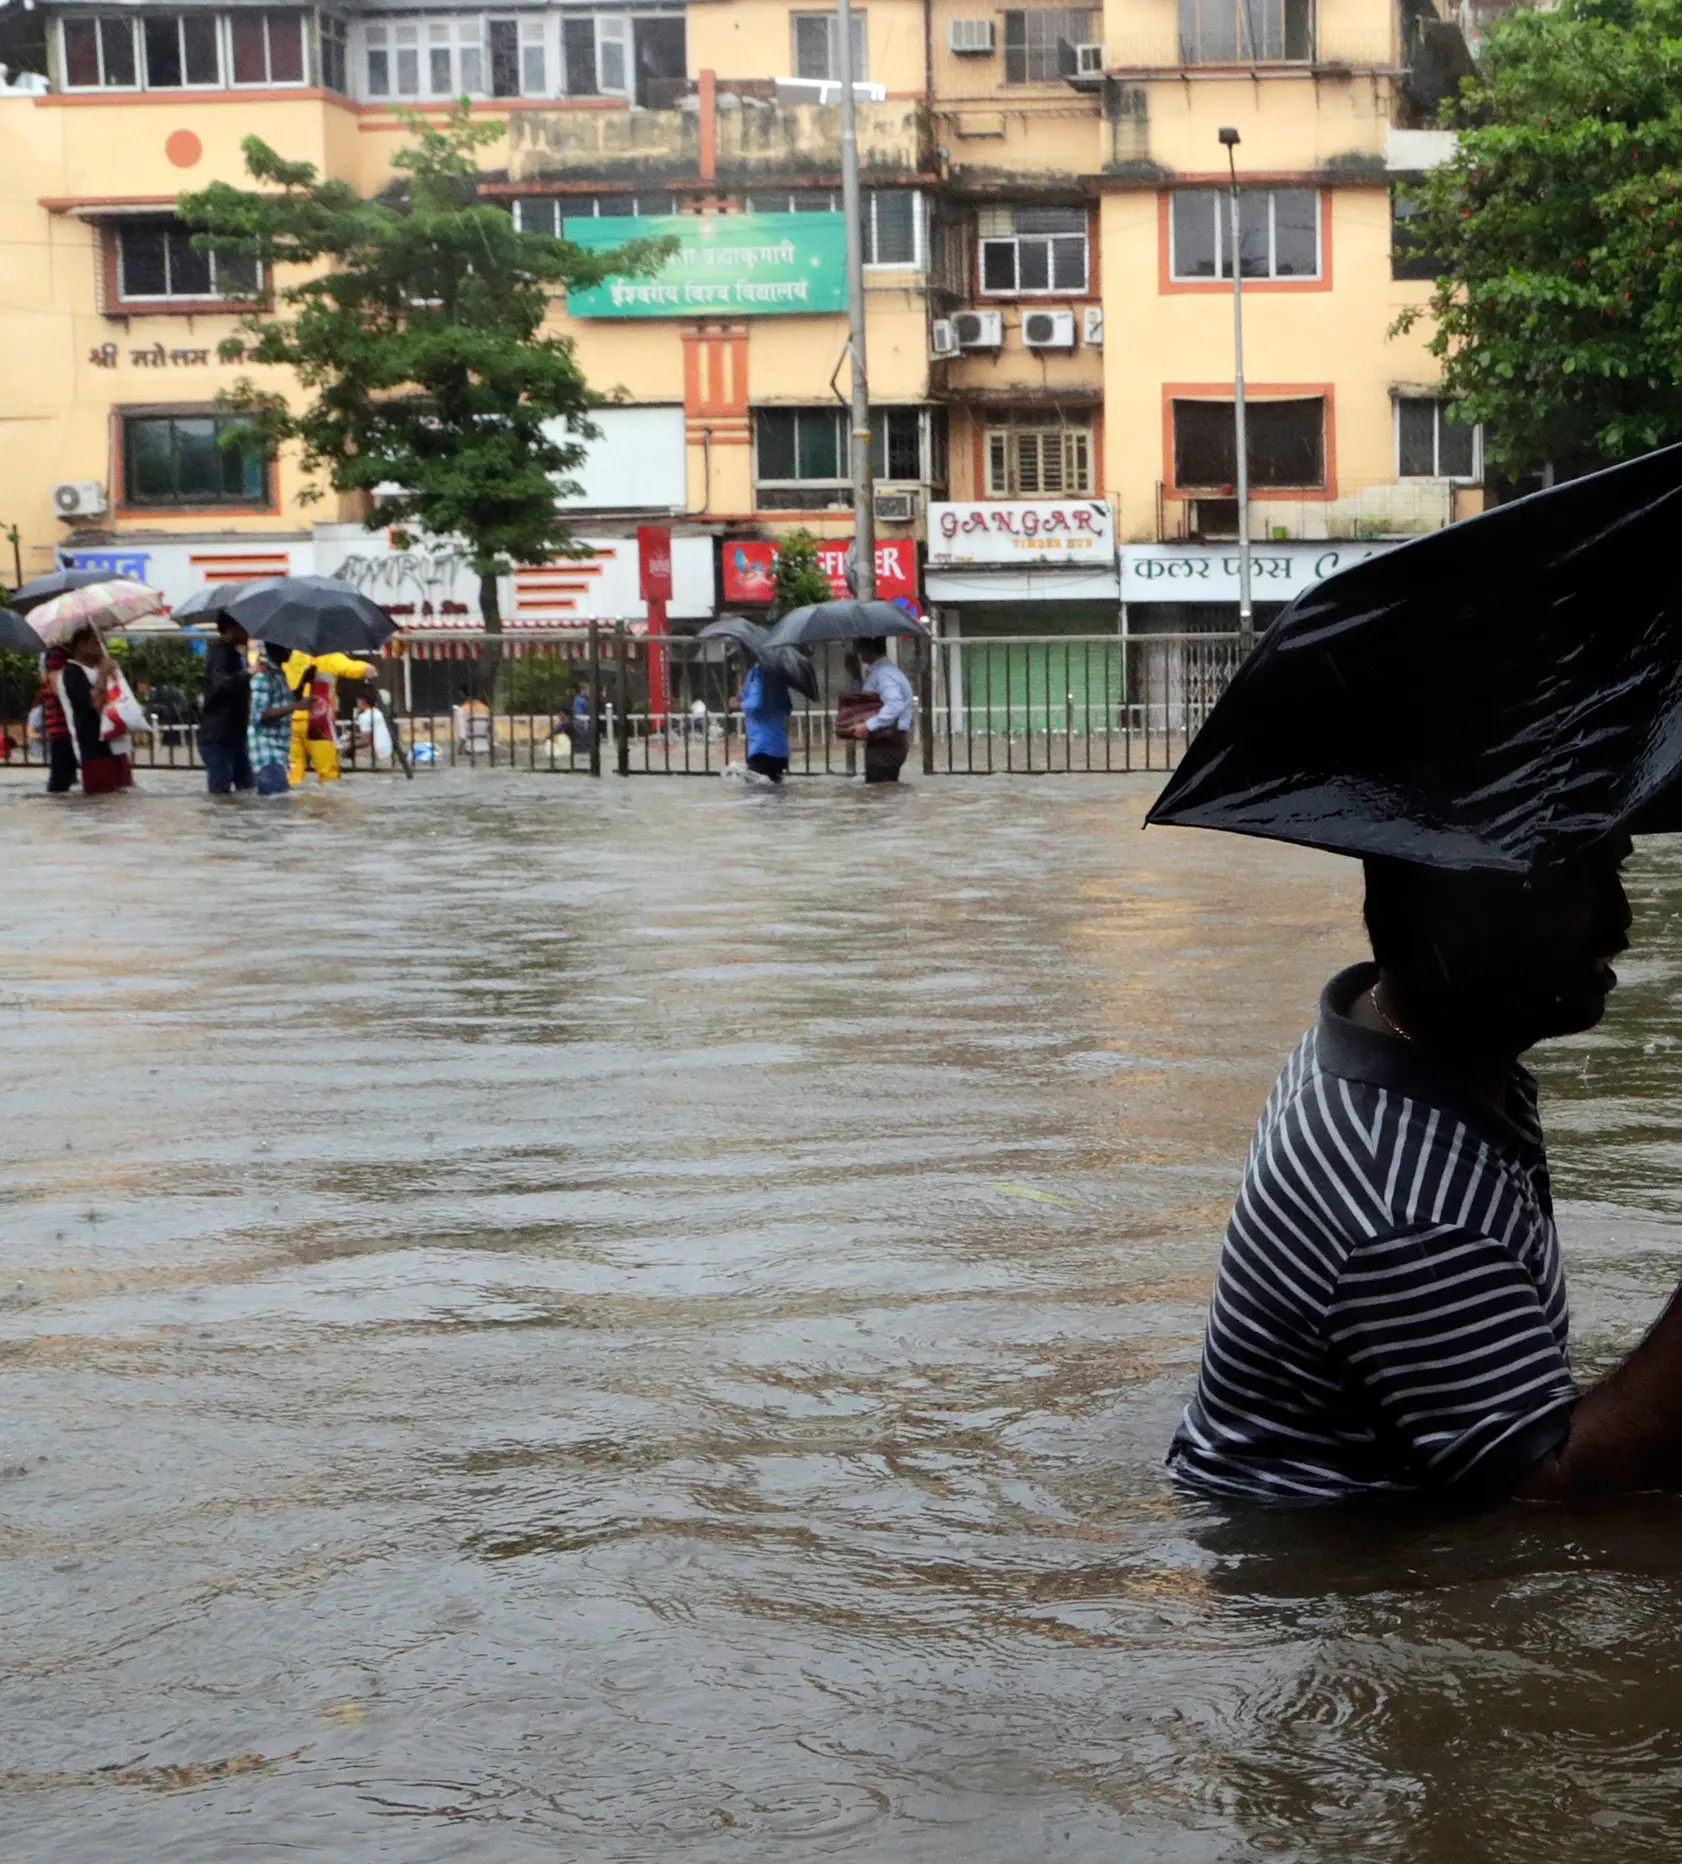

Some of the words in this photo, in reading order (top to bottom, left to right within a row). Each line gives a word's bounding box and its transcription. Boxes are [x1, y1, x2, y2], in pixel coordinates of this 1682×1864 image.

[609, 278, 680, 307] ईश्वरीय
[684, 279, 731, 305] विश्व
[89, 341, 118, 369] श्री
[940, 510, 1104, 538] GANGAR
[1132, 556, 1212, 580] कलर
